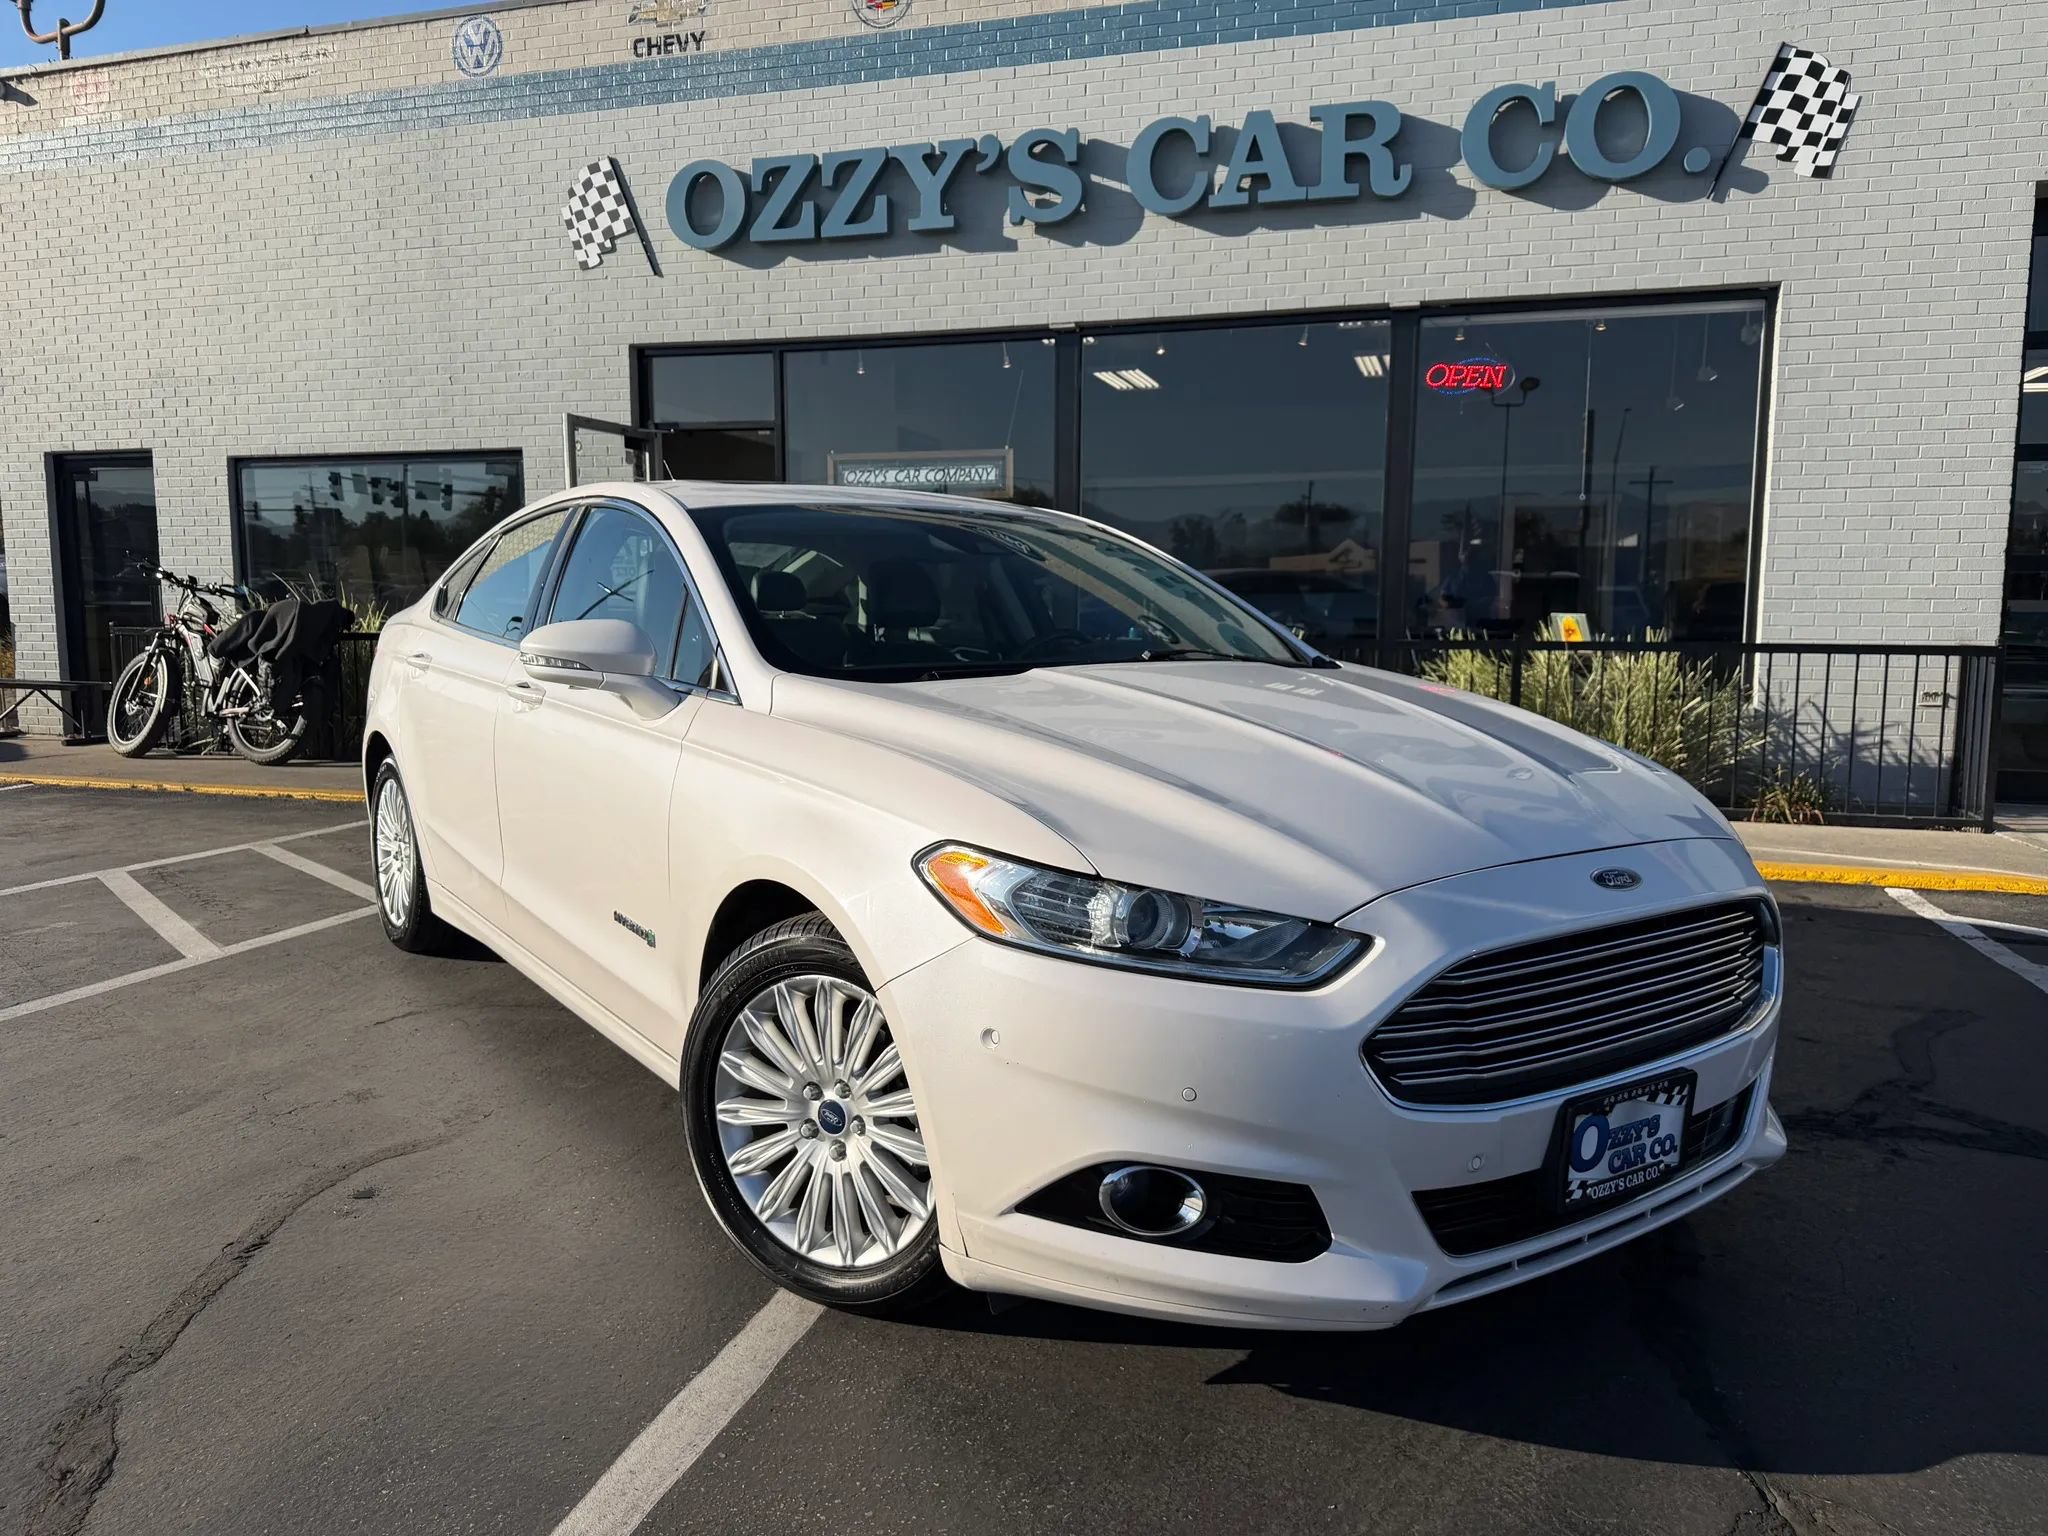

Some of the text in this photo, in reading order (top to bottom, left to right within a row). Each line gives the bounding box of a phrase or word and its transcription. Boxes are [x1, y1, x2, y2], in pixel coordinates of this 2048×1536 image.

[633, 30, 706, 58] CHEVY
[665, 70, 1712, 251] OZZY'S CAR CO.
[1425, 362, 1508, 389] OPEN
[894, 469, 921, 484] CAR
[925, 465, 994, 483] COMPANY
[1607, 1133, 1678, 1175] CAR CO.
[1591, 1165, 1661, 1199] OZZY'S CAR CO.
